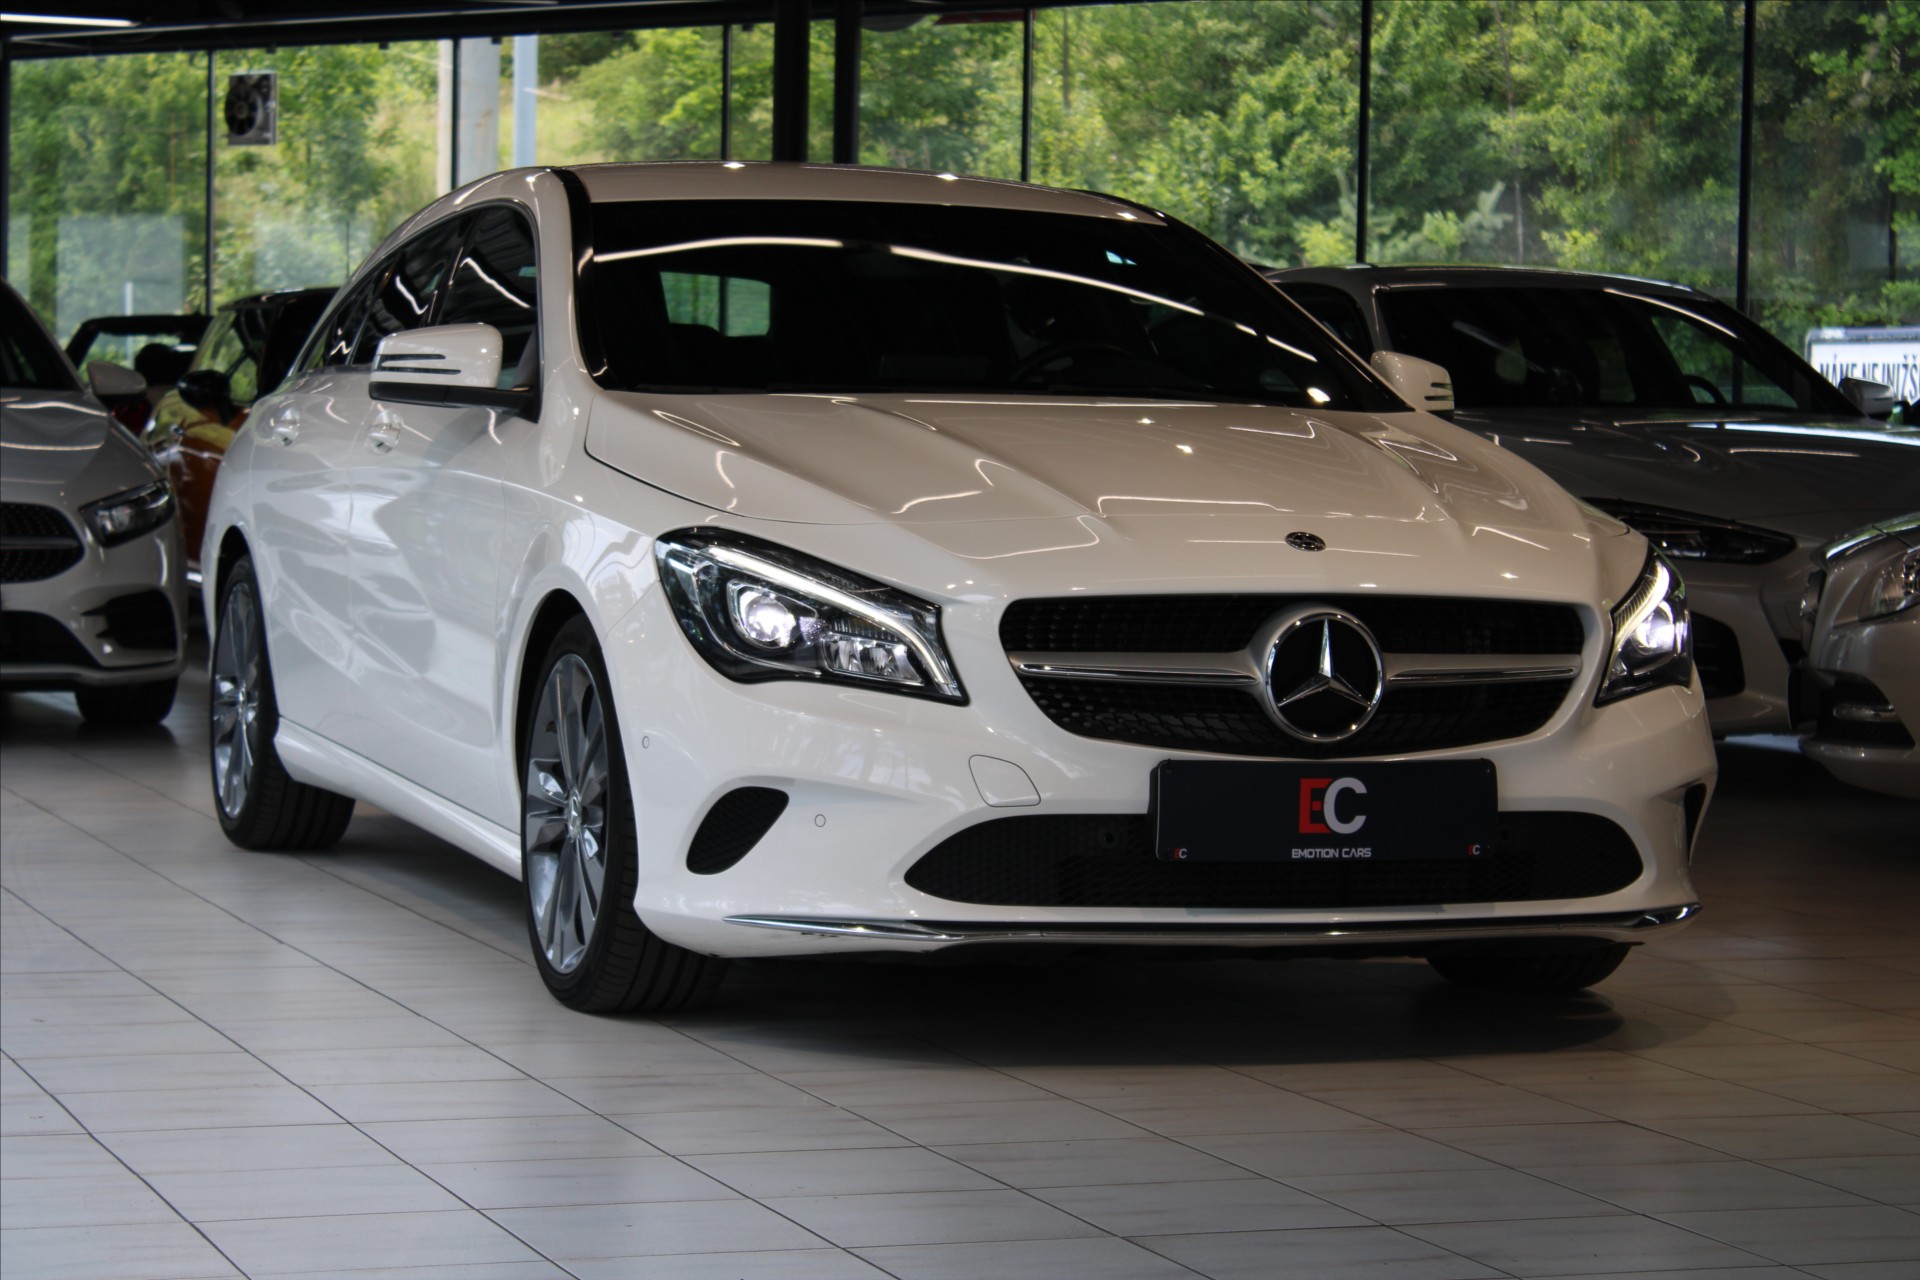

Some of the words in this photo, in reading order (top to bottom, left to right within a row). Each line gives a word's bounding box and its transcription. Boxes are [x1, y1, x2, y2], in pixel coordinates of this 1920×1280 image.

[1862, 353, 1920, 400] NIŽŠ
[1298, 777, 1368, 835] EC
[1173, 848, 1187, 859] EC
[1291, 848, 1339, 859] EMOTION
[1341, 848, 1372, 858] CARS
[1467, 845, 1480, 855] EC
